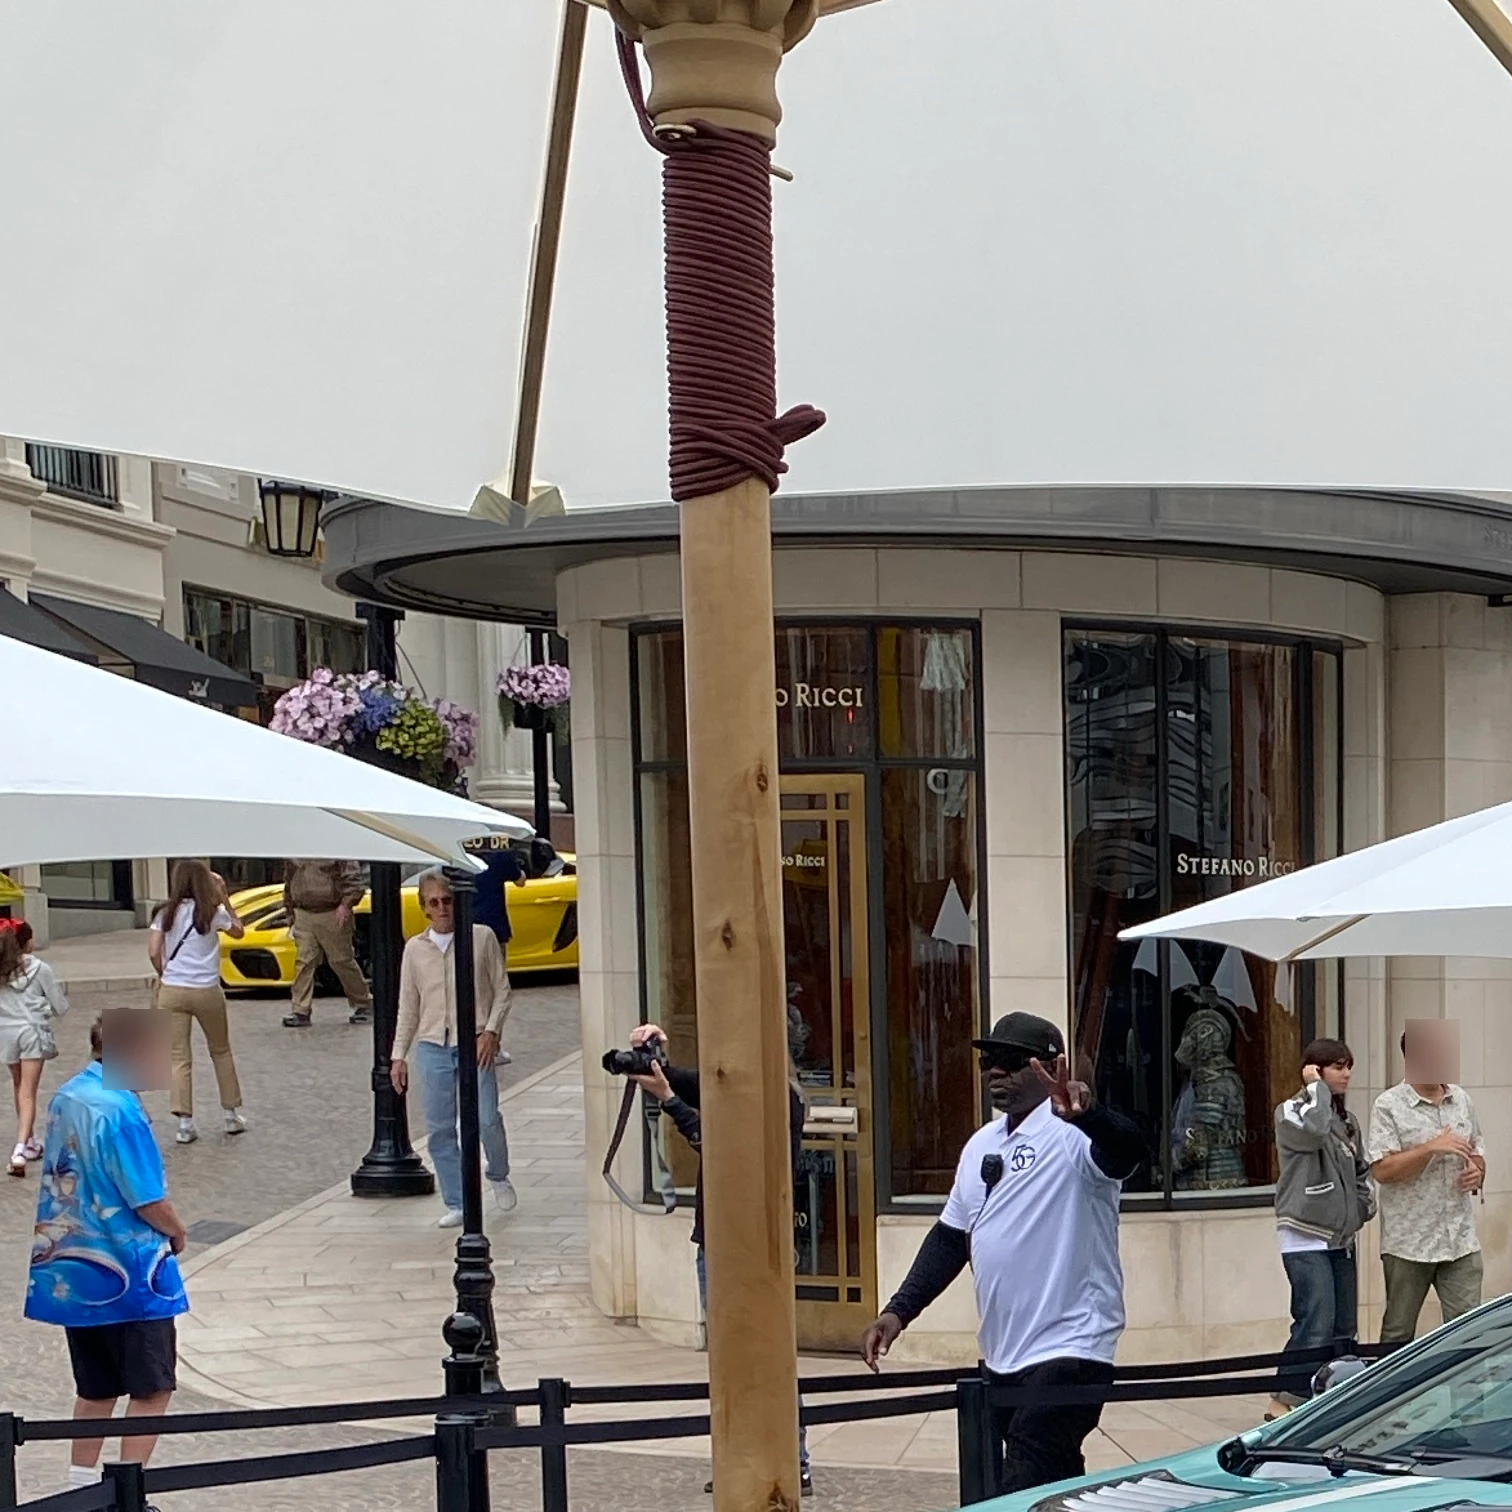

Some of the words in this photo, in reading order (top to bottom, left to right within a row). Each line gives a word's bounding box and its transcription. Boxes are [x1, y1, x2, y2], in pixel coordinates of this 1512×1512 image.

[795, 682, 863, 707] RICCI
[490, 835, 509, 849] DR
[795, 853, 826, 867] RICCI
[1177, 853, 1255, 876] STEFANO
